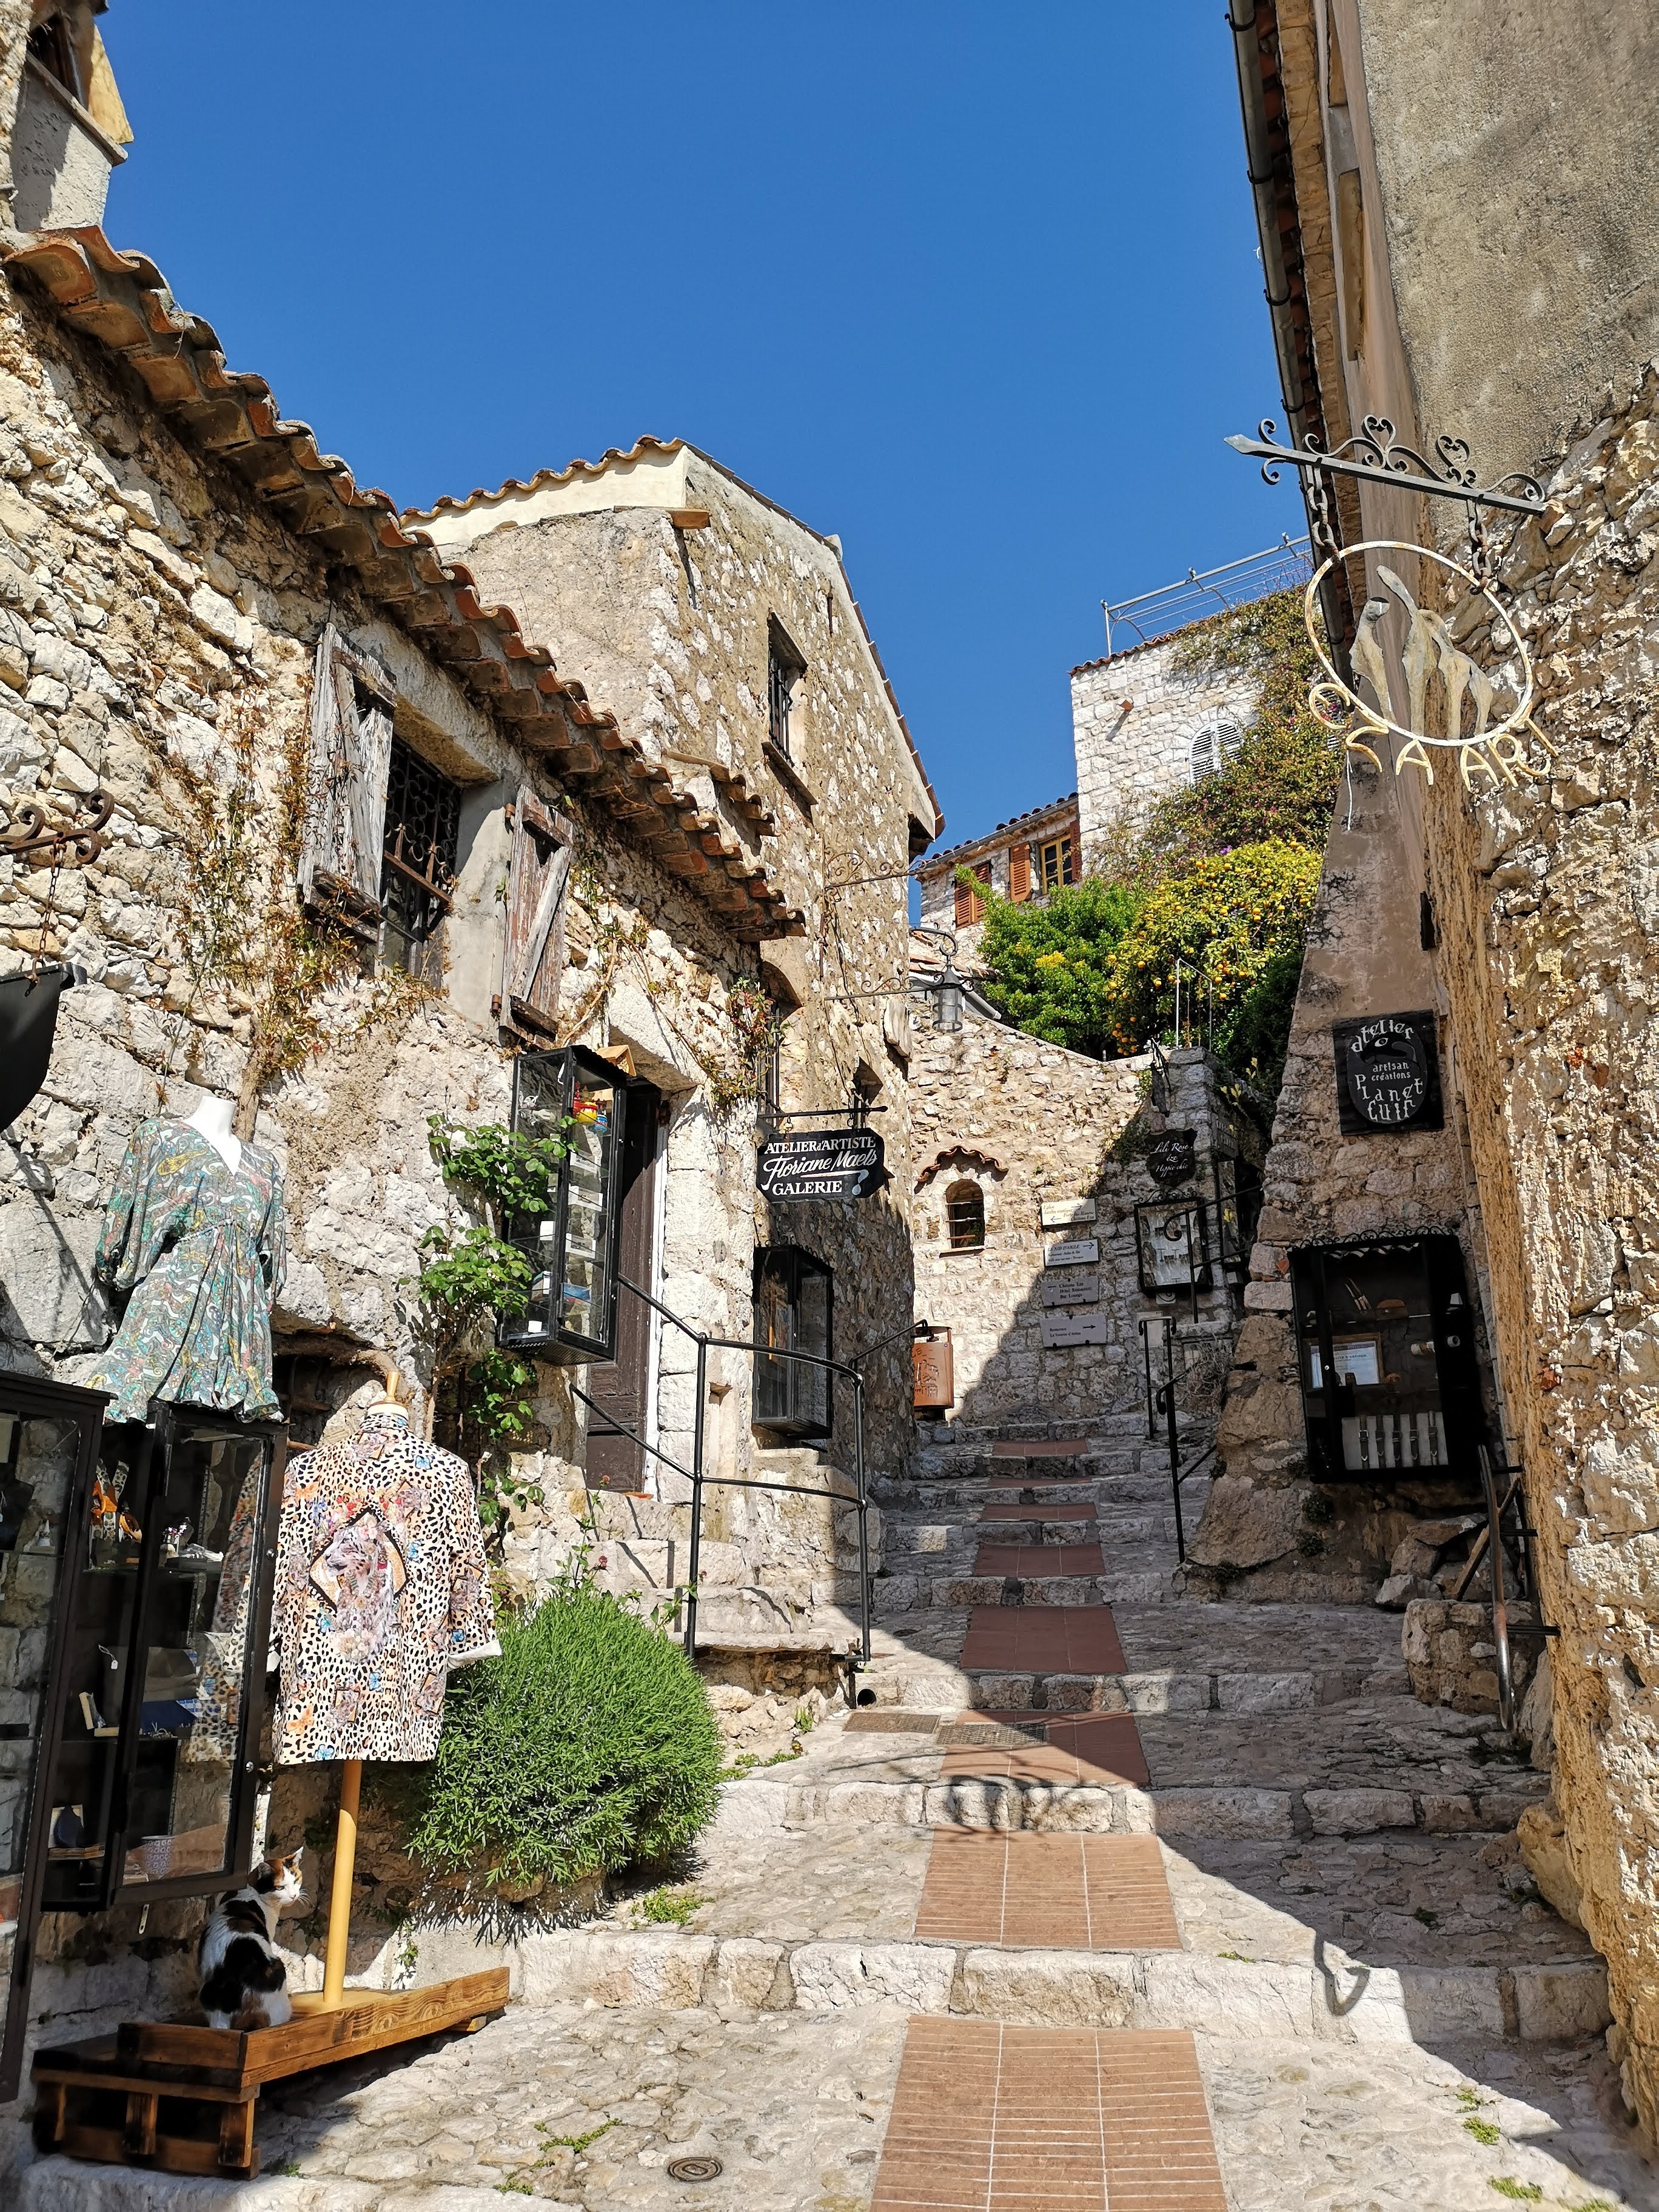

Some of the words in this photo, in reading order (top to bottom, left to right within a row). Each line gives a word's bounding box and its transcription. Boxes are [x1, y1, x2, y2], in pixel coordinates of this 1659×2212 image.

[1460, 700, 1560, 792] ART
[1371, 1071, 1411, 1081] créations
[1372, 1062, 1410, 1072] artisan
[1354, 1074, 1423, 1102] Planet
[764, 1141, 817, 1154] ATELIER
[817, 1136, 876, 1151] d'ARTISTE
[760, 1155, 833, 1191] Floriane
[773, 1181, 842, 1195] GALERIE
